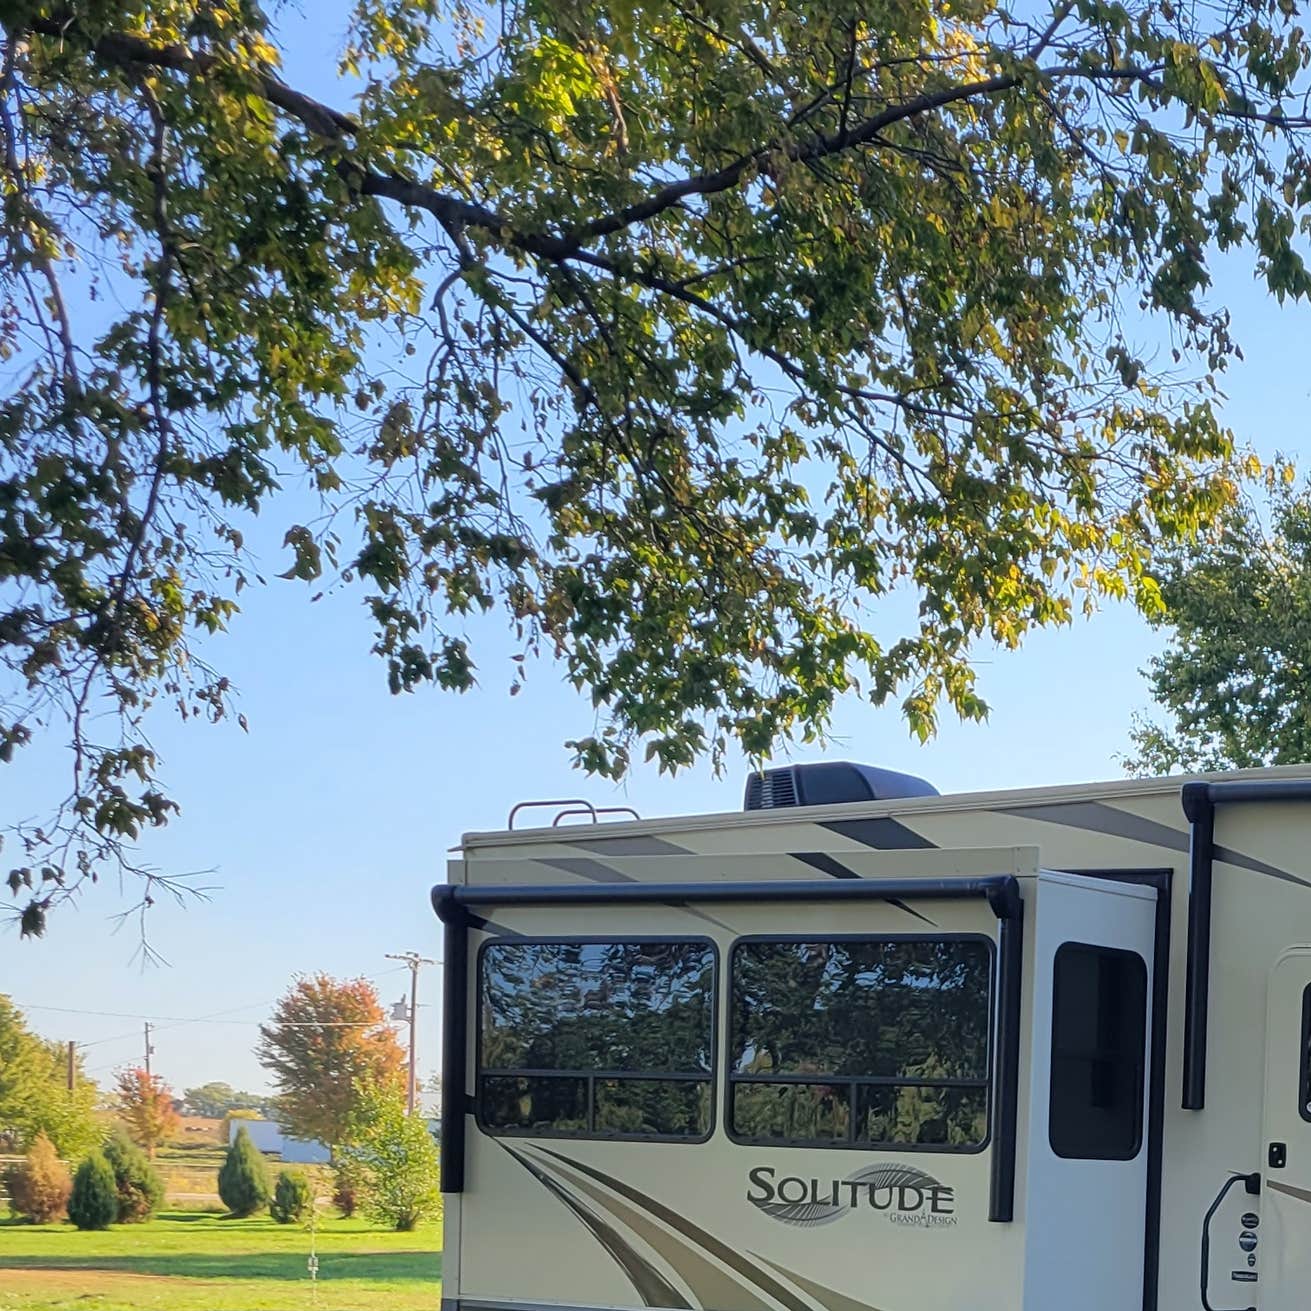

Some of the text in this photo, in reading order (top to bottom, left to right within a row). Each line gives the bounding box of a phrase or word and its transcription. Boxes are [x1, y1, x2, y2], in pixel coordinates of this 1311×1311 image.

[747, 1167, 954, 1214] SOLITUDE
[889, 1212, 958, 1225] GRAND DESIGN
